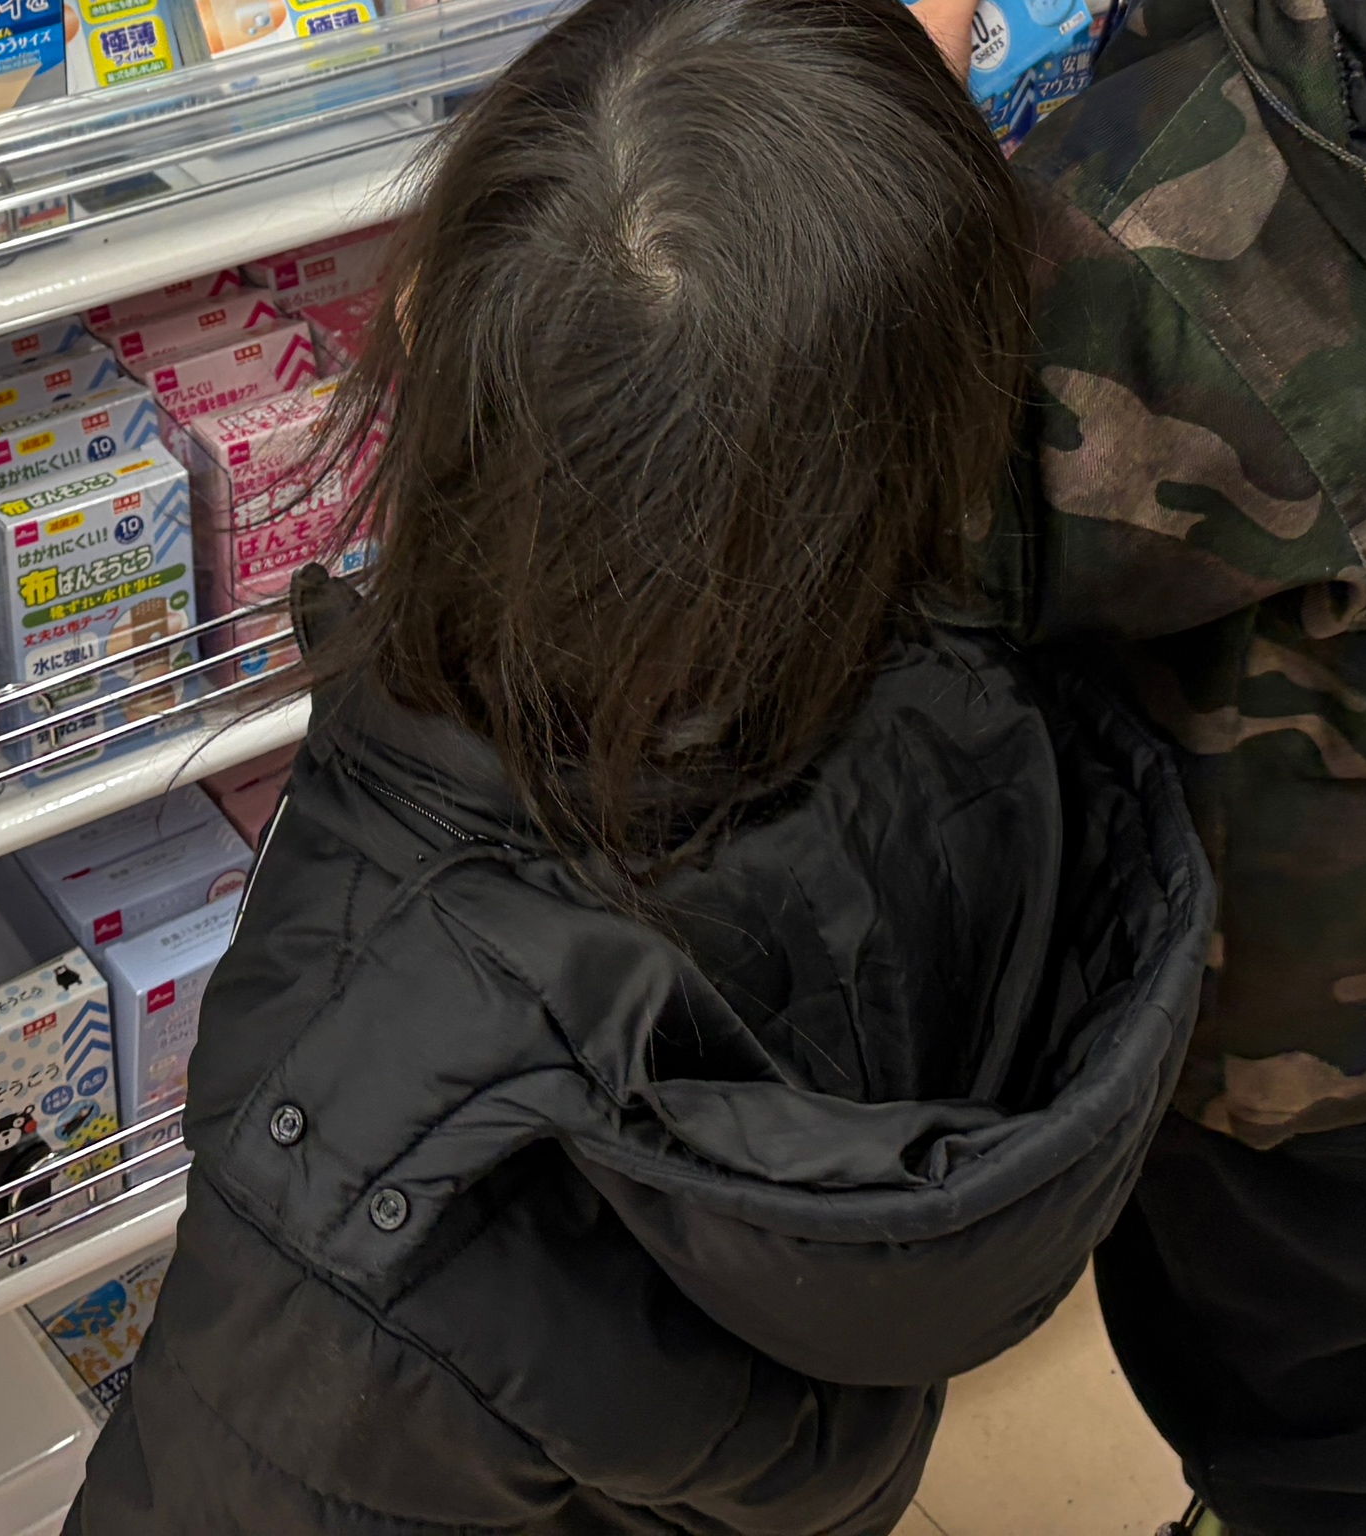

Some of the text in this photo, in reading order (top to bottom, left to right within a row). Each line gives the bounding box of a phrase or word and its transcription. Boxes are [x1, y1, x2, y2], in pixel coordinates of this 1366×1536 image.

[119, 517, 140, 535] 10
[17, 526, 109, 569] はがれにくい!
[19, 542, 153, 607] 布ばんそうこう
[33, 643, 95, 677] 水に強い
